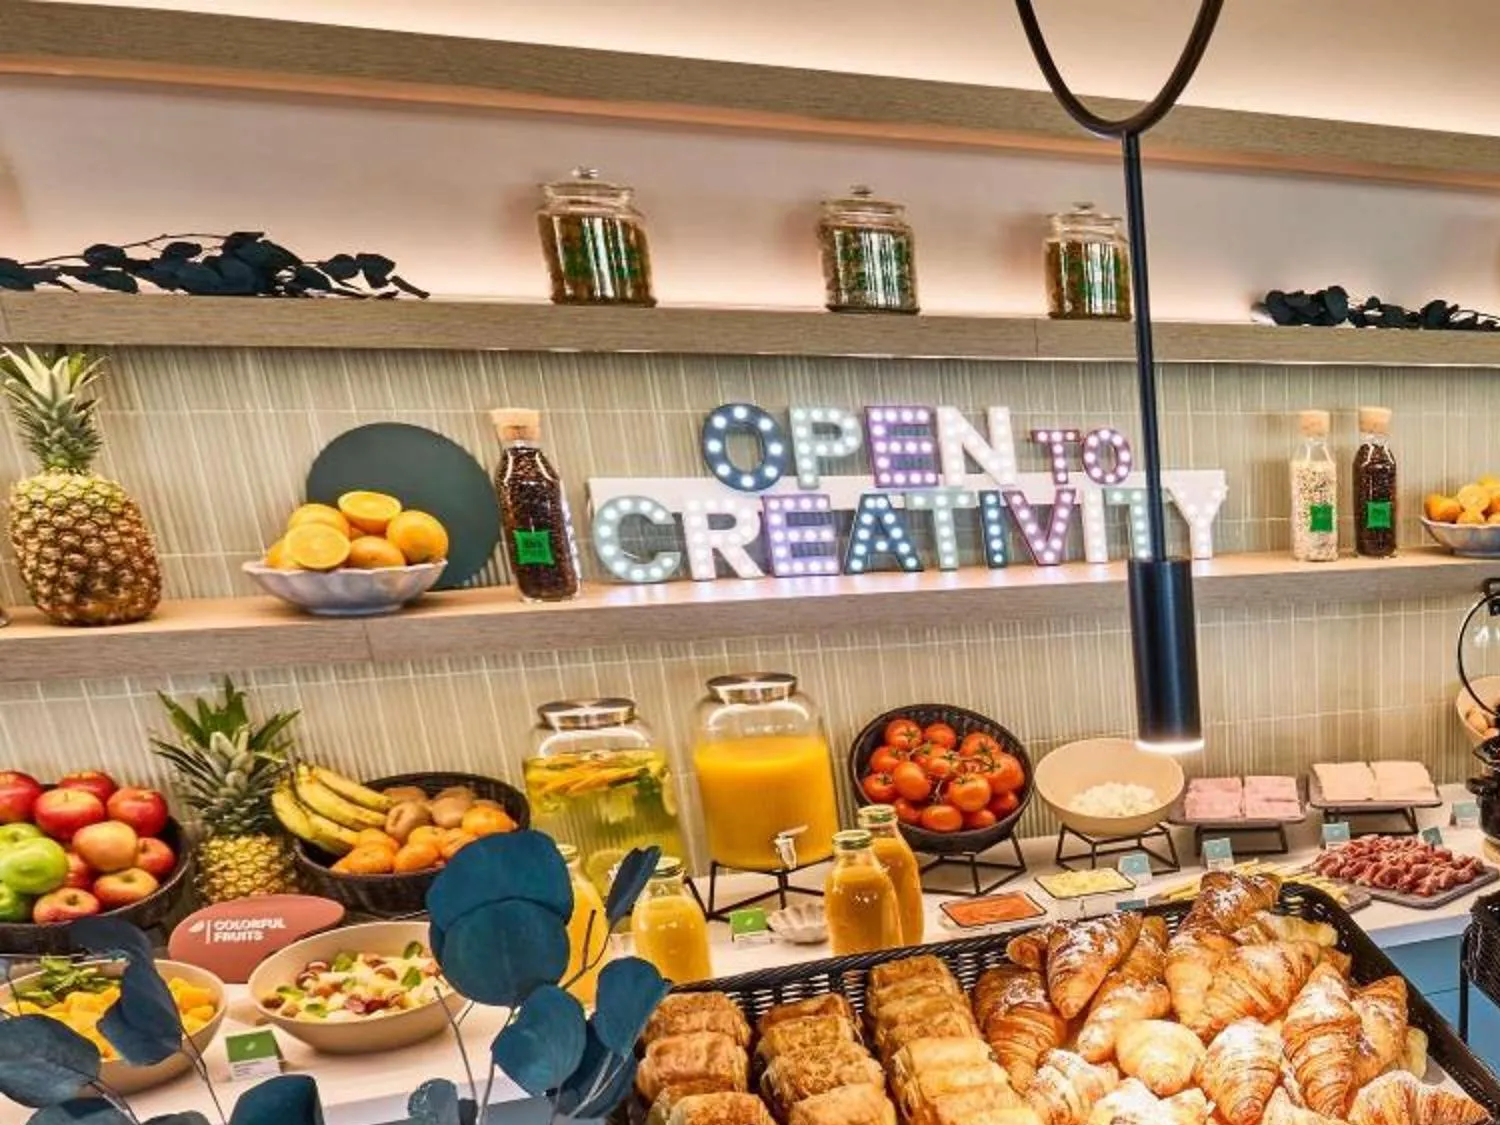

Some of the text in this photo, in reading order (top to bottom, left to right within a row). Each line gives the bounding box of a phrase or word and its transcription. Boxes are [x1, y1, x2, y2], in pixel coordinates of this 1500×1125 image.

[703, 403, 1131, 491] OPEN TO
[592, 487, 1228, 583] CREATIVITY
[213, 917, 286, 931] COLORFUL
[213, 931, 264, 943] FRUITS
